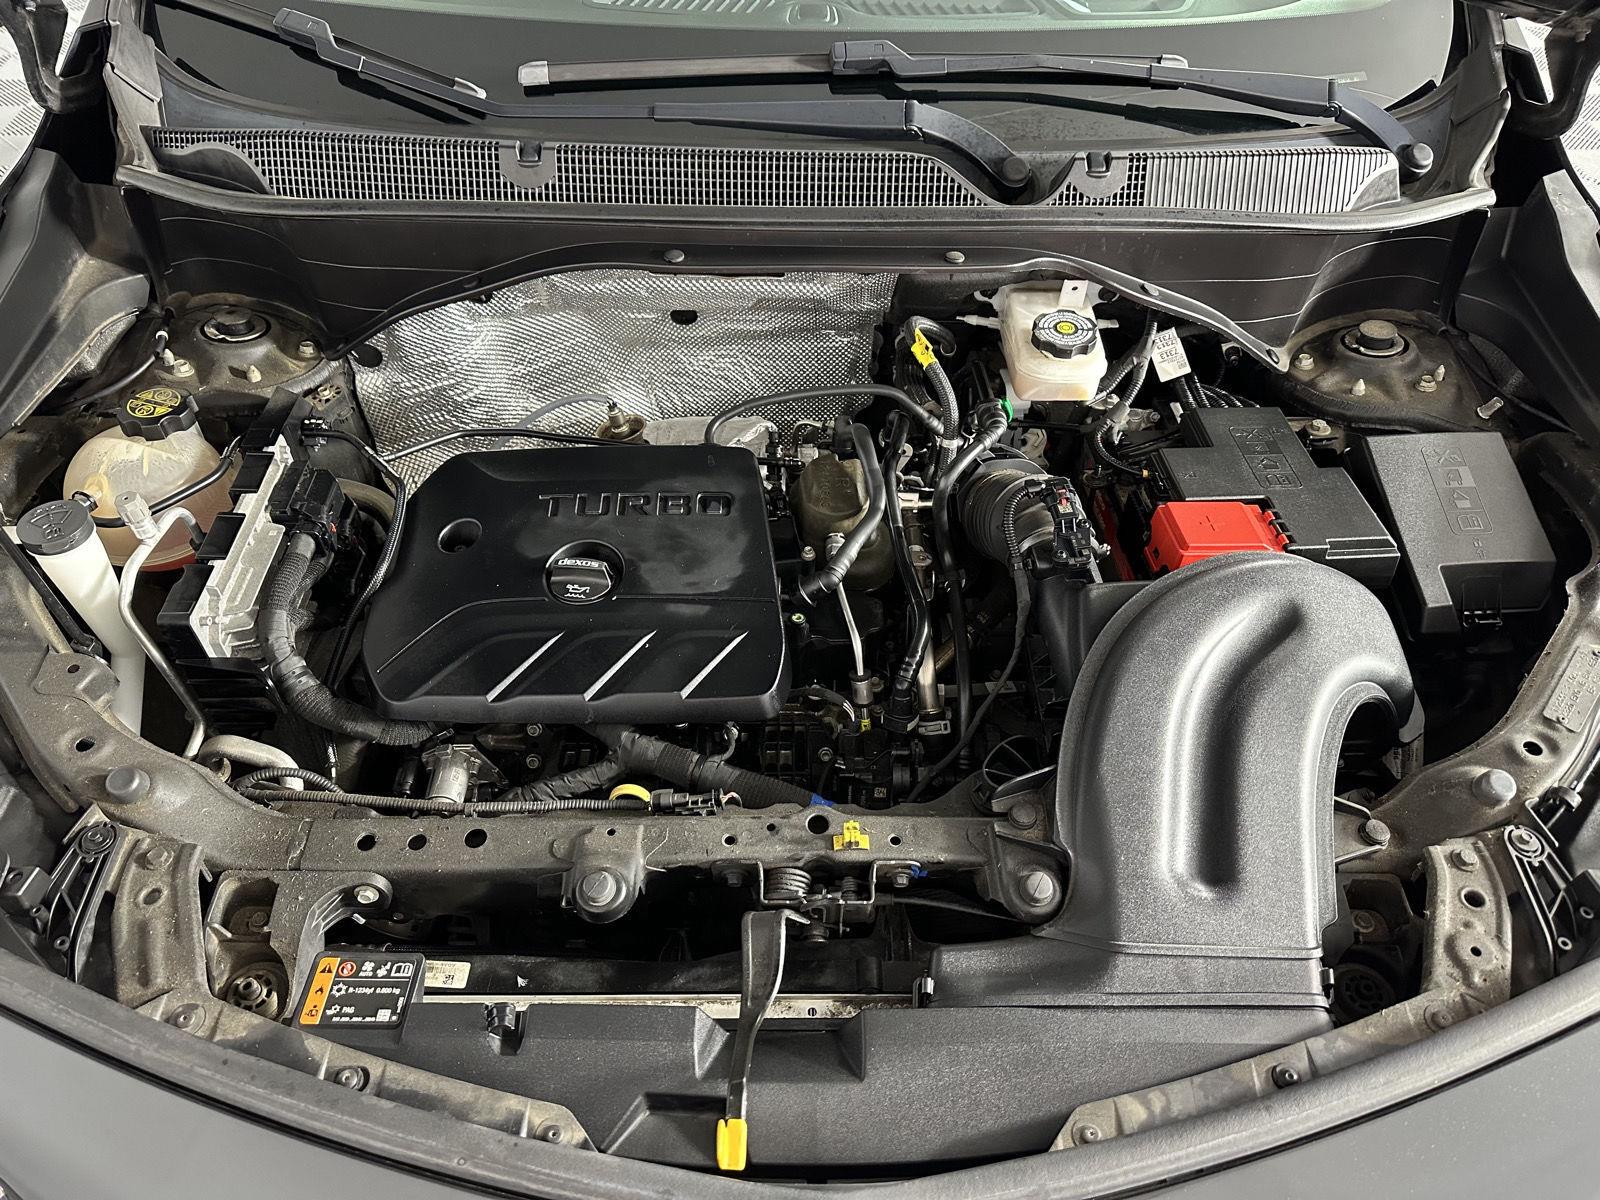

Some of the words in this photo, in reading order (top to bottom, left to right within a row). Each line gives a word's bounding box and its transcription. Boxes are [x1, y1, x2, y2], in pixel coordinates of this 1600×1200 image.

[1159, 348, 1179, 360] 7313
[538, 491, 734, 517] TURBO
[558, 557, 600, 568] dexos
[341, 1006, 355, 1014] PAG
